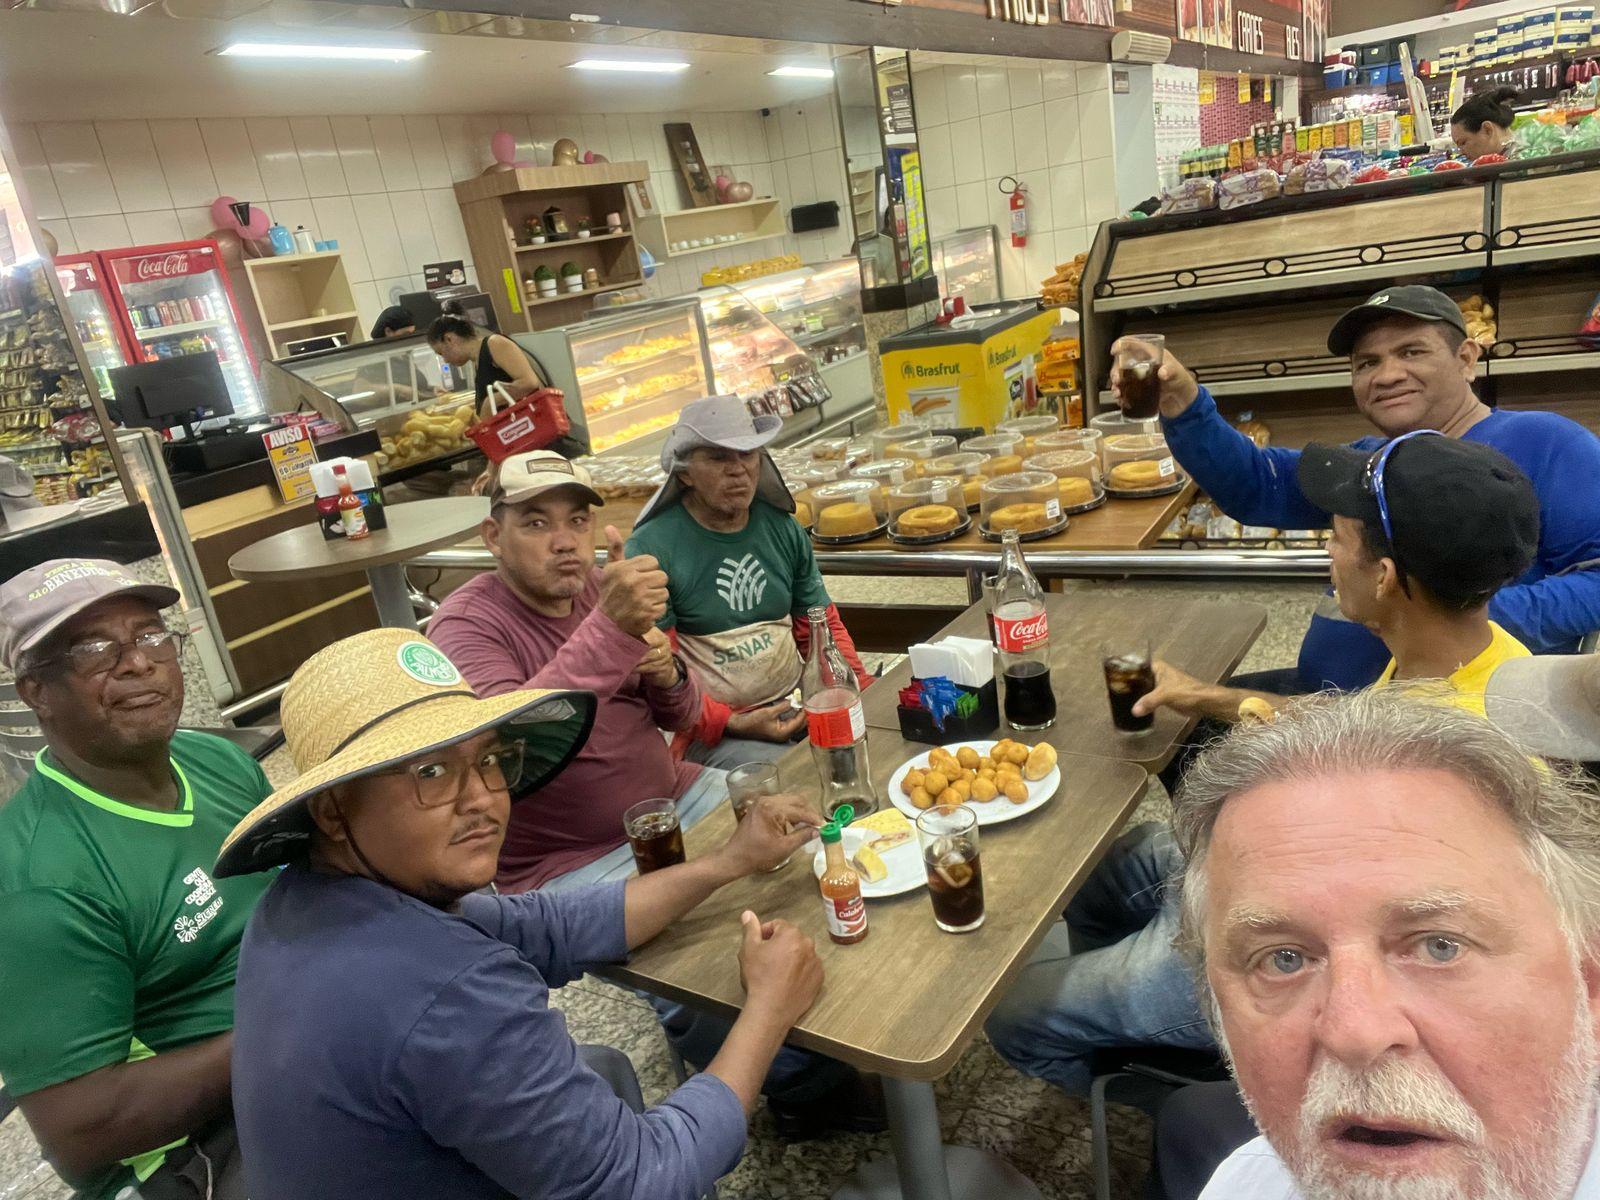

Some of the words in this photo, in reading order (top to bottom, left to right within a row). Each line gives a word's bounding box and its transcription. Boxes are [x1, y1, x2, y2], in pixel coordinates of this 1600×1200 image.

[138, 254, 188, 279] Coca-Cola
[915, 363, 960, 377] Brasfrut
[270, 426, 303, 447] AVISO
[713, 632, 775, 665] SENAR
